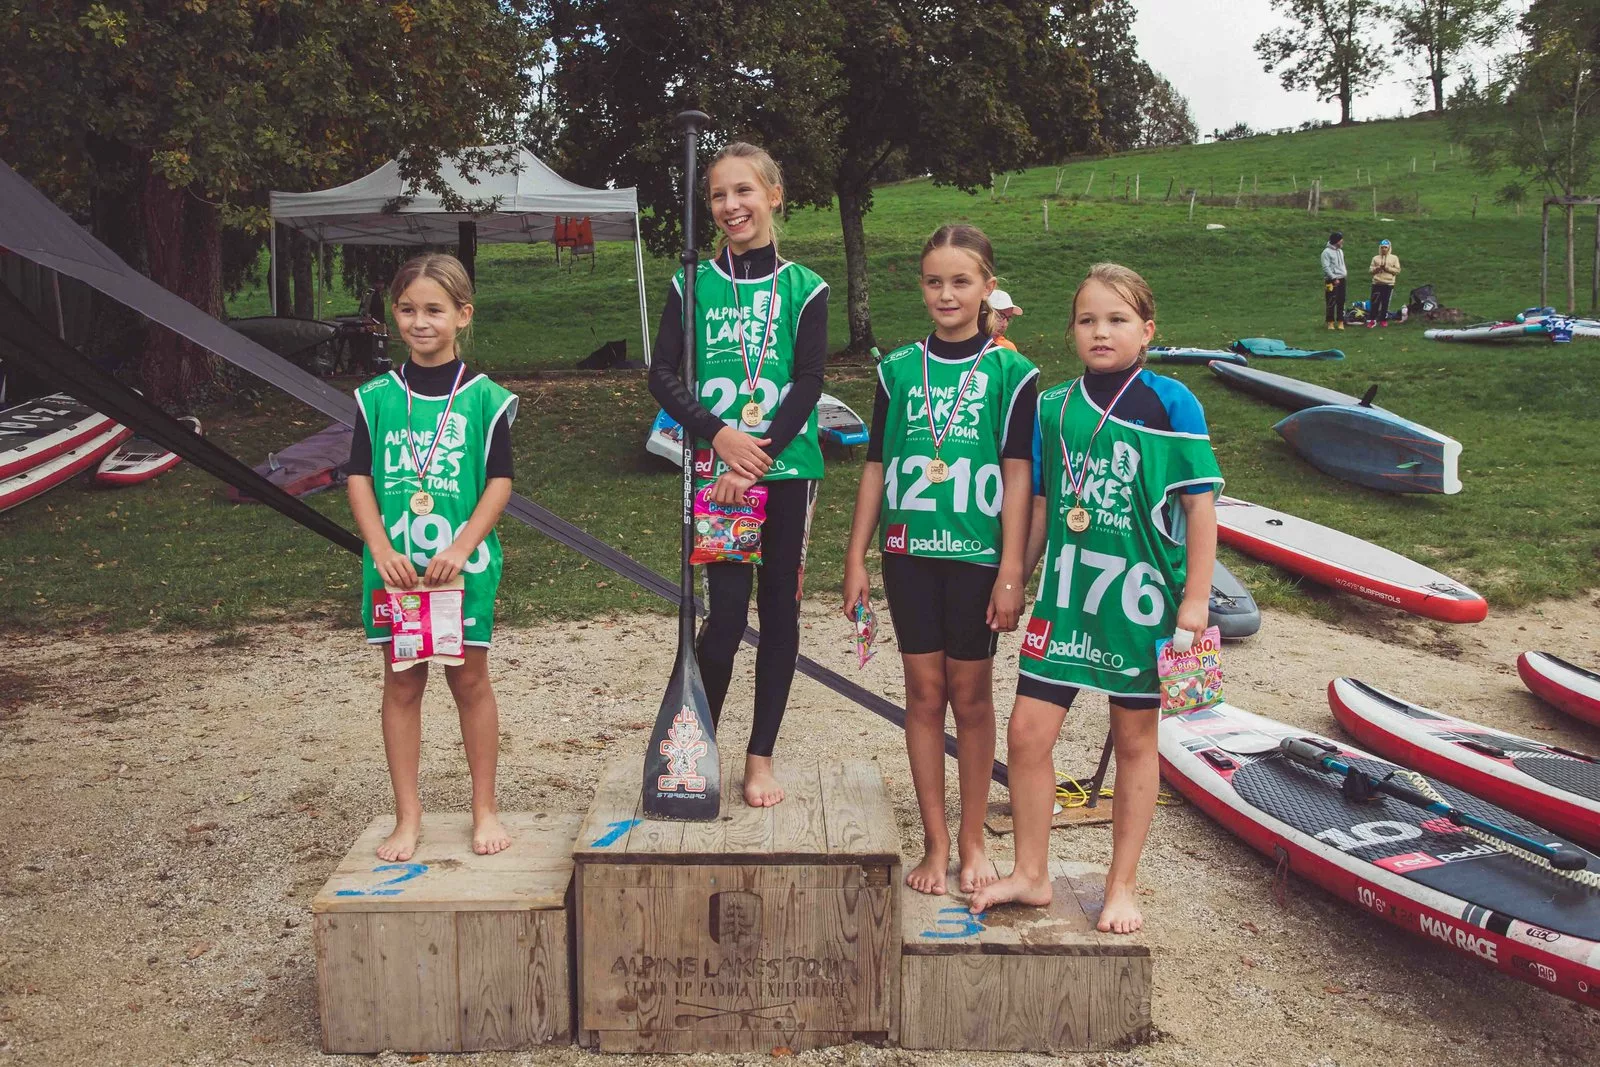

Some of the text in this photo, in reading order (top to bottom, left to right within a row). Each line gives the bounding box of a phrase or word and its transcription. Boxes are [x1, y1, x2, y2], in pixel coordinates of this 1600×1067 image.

[705, 306, 752, 320] ALPINE
[949, 424, 980, 440] TOUR
[423, 475, 461, 493] TOUR
[683, 448, 692, 525] STARBOARD
[884, 455, 1004, 518] 1210
[1096, 508, 1133, 531] TOUR
[887, 524, 907, 549] red
[1359, 585, 1401, 604] SURFPISTOLS
[1022, 620, 1051, 650] red
[656, 792, 707, 800] STARBOARD
[1313, 819, 1423, 851] 10
[1392, 855, 1433, 869] red
[336, 863, 429, 896] 2
[919, 907, 989, 939] 3
[1420, 913, 1455, 945] MAX
[1455, 928, 1499, 964] RACE
[611, 956, 698, 979] ALPINE
[703, 956, 782, 979] LAKES
[624, 981, 667, 997] STAND
[675, 981, 693, 997] UP
